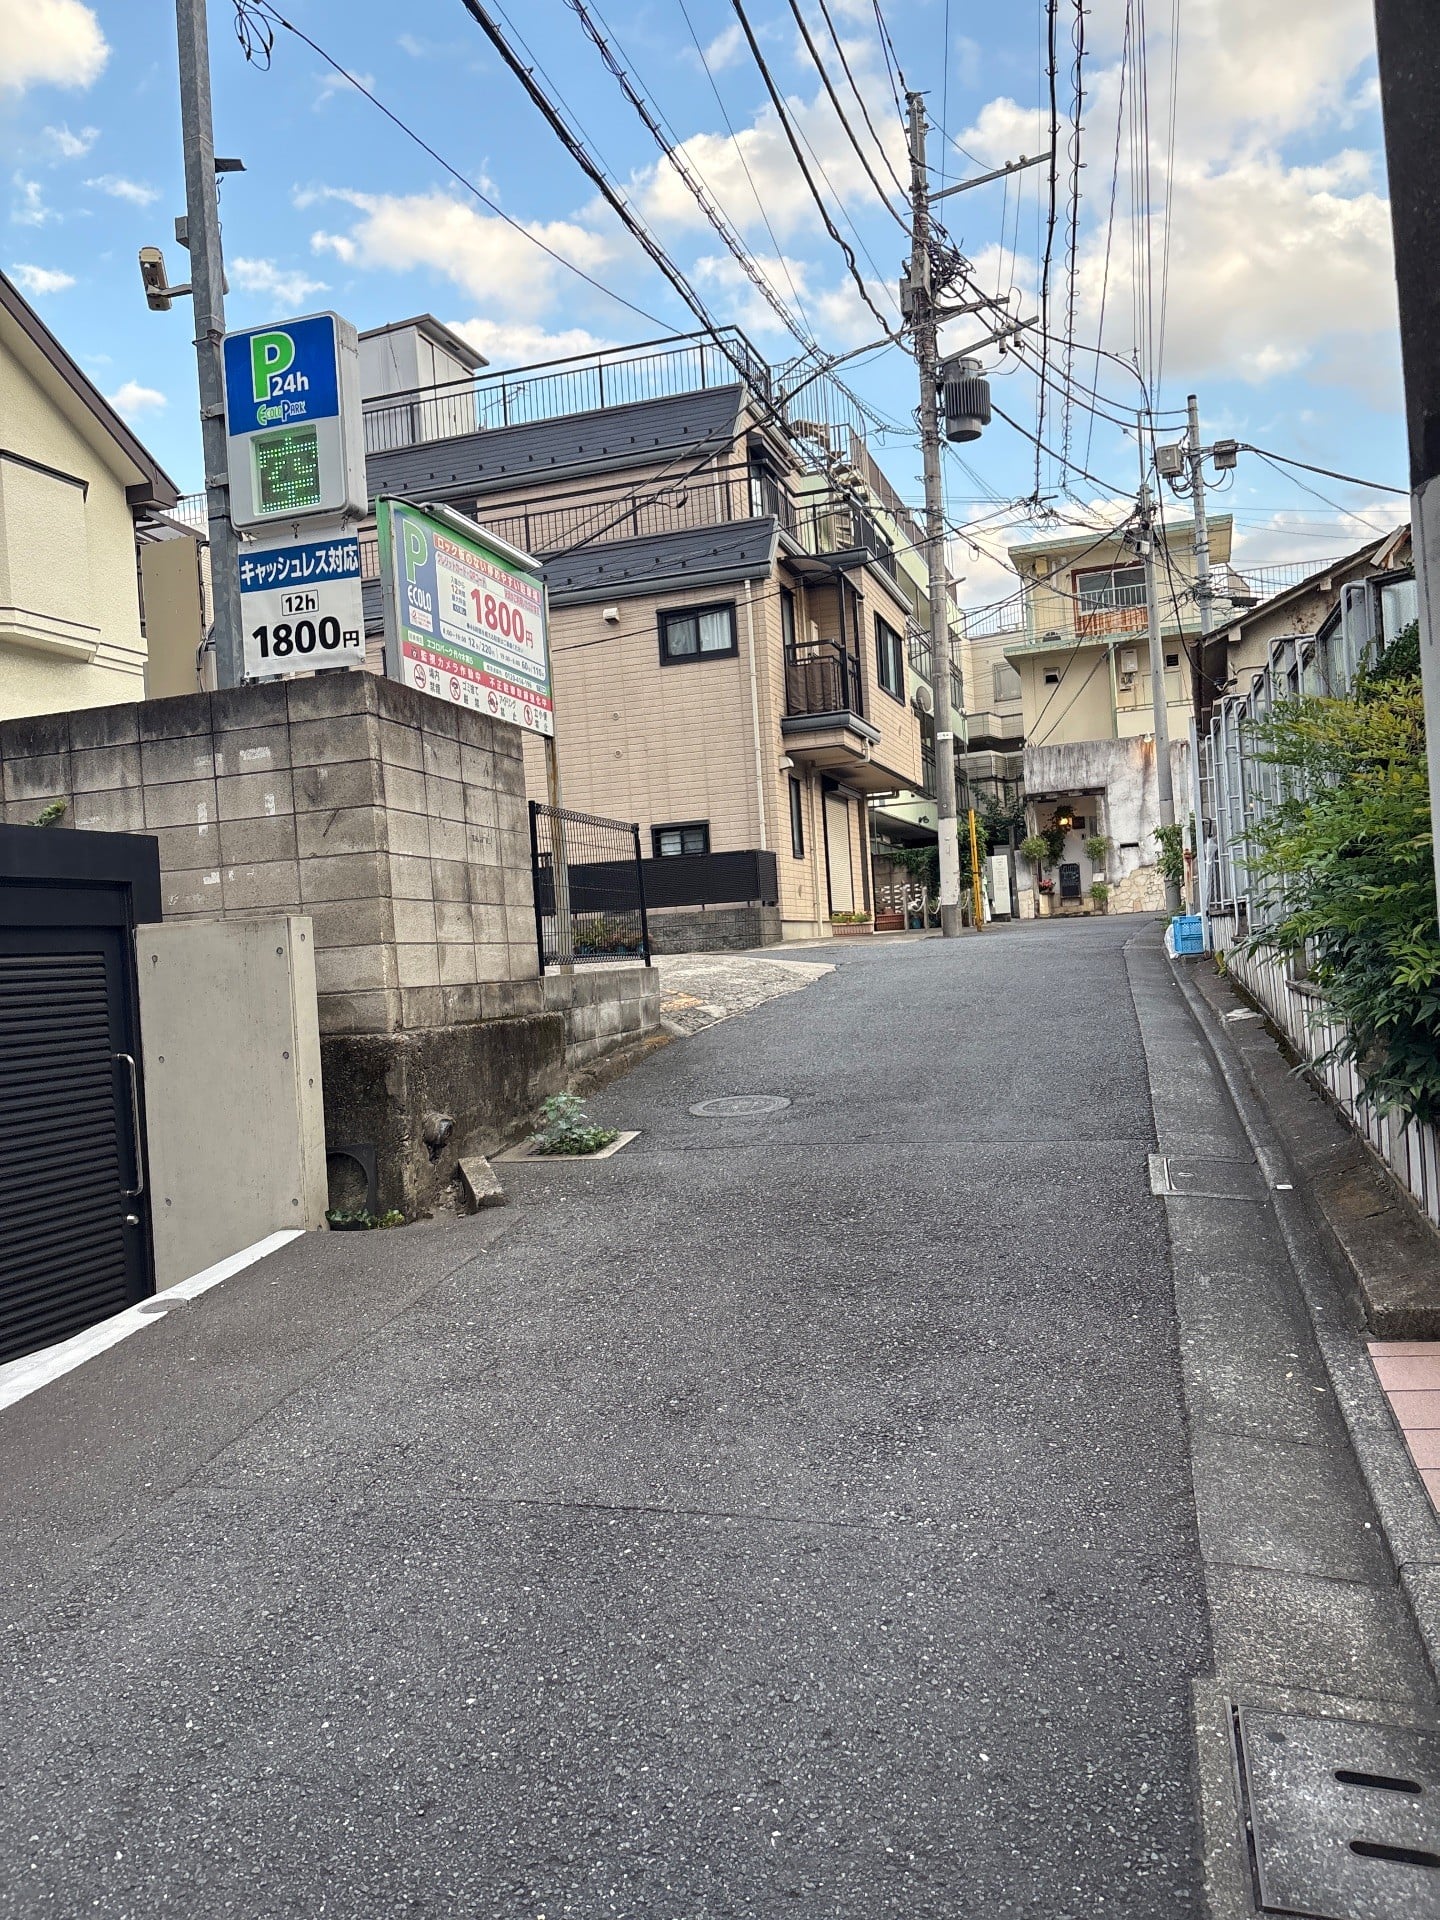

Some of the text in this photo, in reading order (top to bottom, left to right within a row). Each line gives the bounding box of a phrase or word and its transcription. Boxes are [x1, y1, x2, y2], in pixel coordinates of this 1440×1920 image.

[250, 331, 296, 403] P
[272, 371, 309, 396] 24h
[259, 437, 321, 512] 空
[240, 544, 359, 586] キャッシュレス対応
[403, 518, 428, 584] P
[284, 594, 316, 613] 12h
[471, 588, 534, 649] 1800円
[252, 616, 360, 658] 1800円
[420, 649, 481, 682] 監視カメラ作動中
